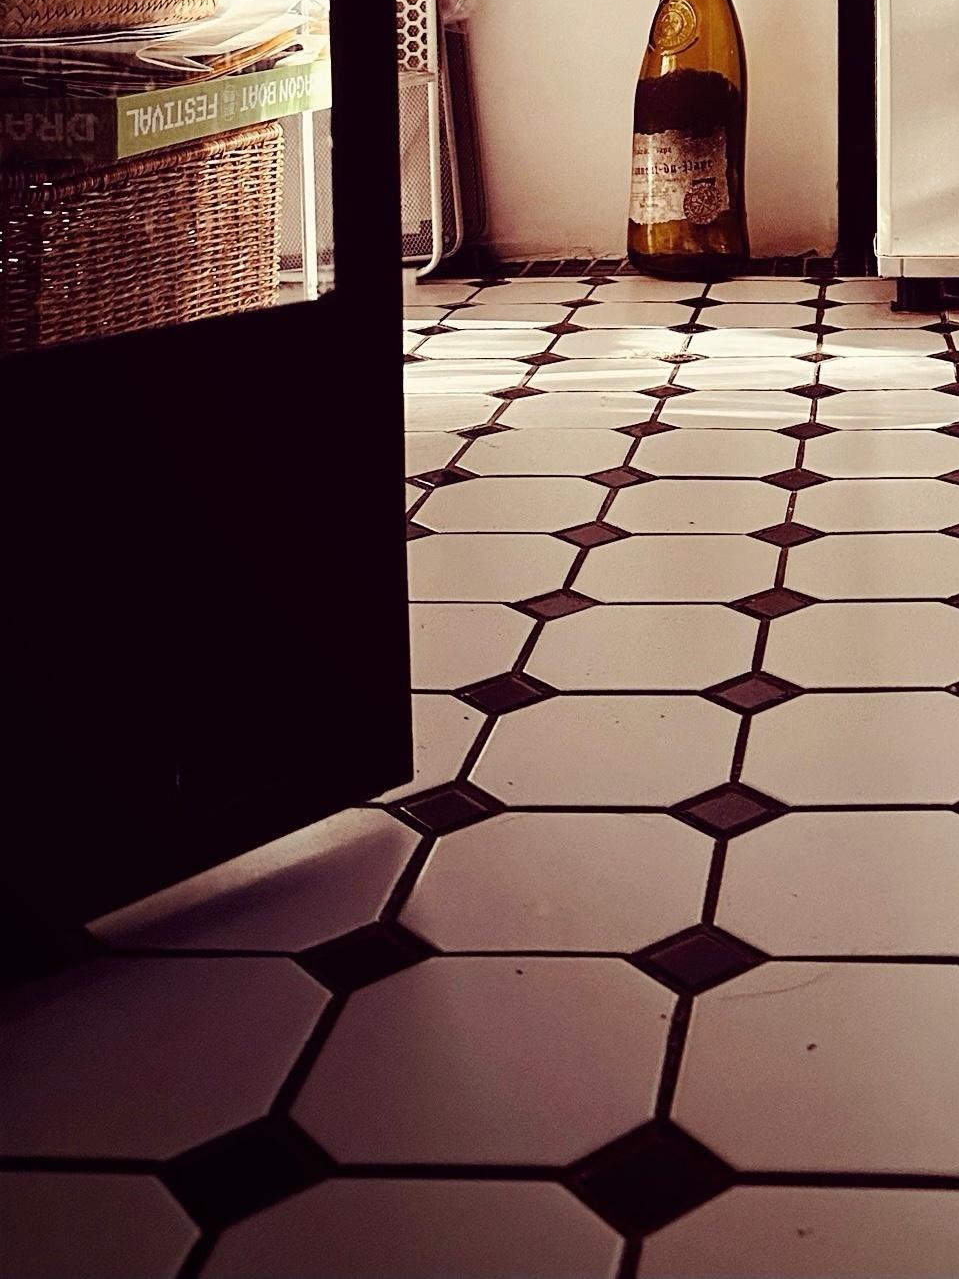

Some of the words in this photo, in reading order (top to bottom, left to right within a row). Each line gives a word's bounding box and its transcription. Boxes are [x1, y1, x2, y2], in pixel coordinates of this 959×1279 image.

[240, 80, 277, 112] BOAT
[280, 72, 321, 103] AGON
[0, 112, 96, 142] DRA
[126, 92, 219, 137] FESTIVAL
